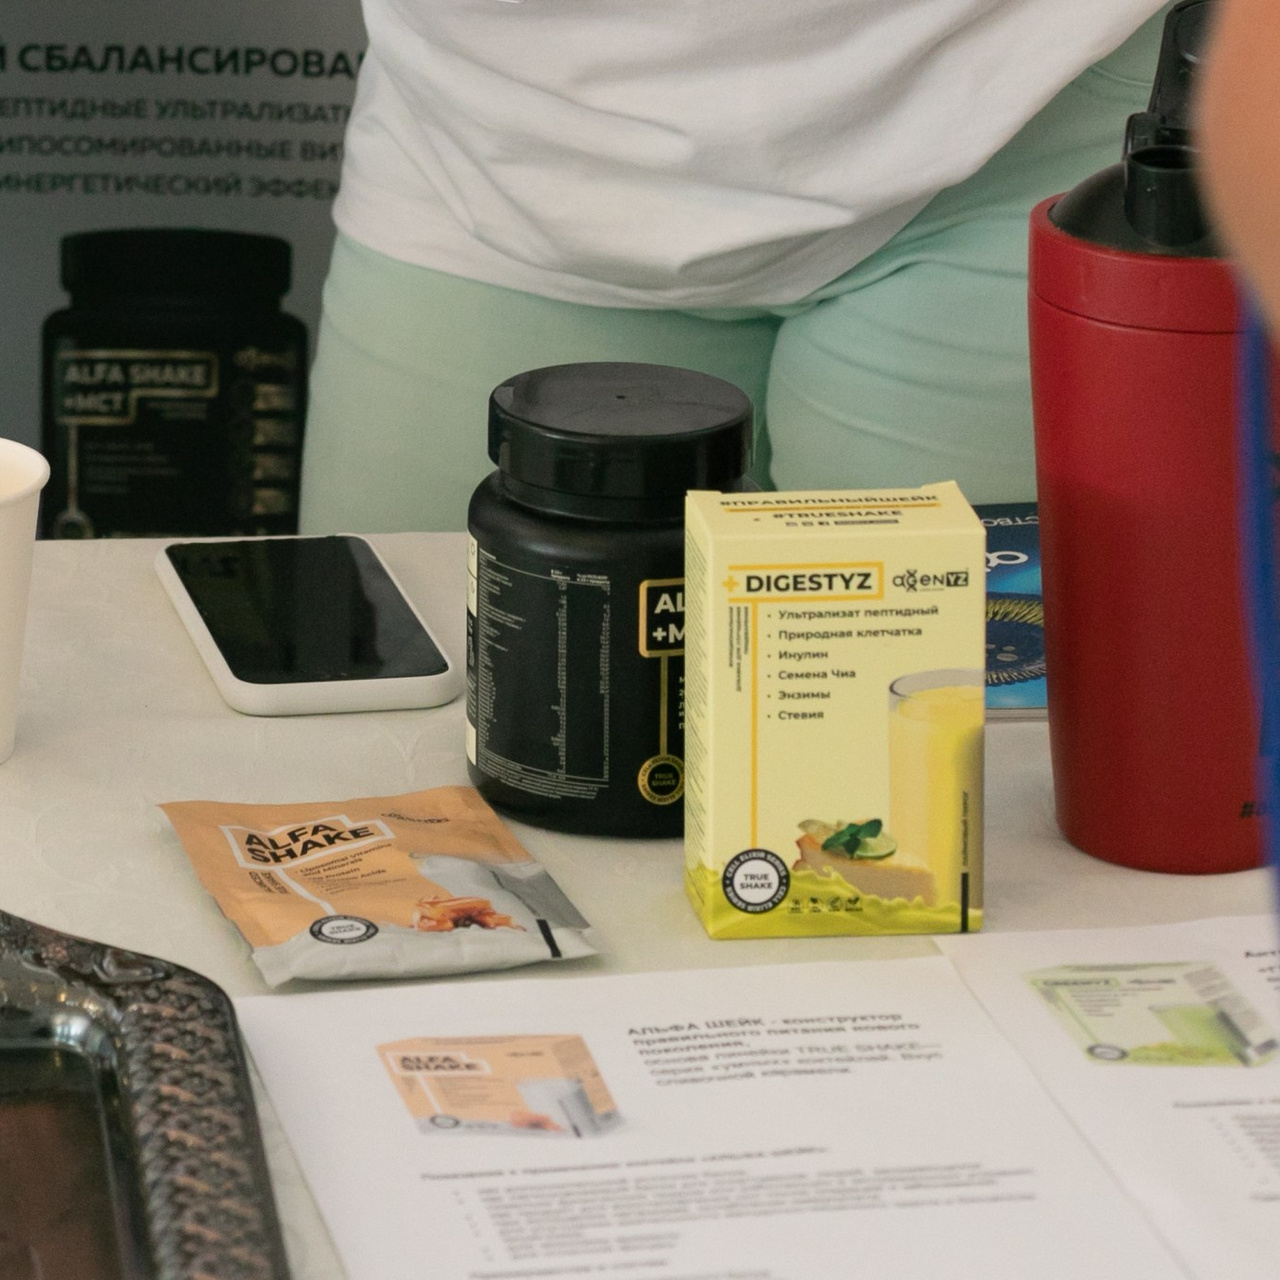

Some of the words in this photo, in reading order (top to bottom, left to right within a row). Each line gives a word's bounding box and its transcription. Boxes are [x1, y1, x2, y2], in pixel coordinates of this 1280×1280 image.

[746, 572, 873, 592] DIGESTYZ
[778, 608, 860, 620] Ультрализат
[864, 605, 940, 618] пептидный
[778, 629, 853, 641] Природная
[857, 627, 923, 638] клетчатка
[778, 650, 829, 662] Инулин
[778, 670, 828, 680] Семена
[831, 669, 857, 679] Чиа
[778, 690, 831, 700] Энзимы
[778, 710, 825, 720] Стевия
[246, 824, 339, 850] ALFA
[247, 826, 375, 864] SHAKE
[743, 873, 770, 881] TRUE
[628, 1022, 699, 1036] АЛЬФА
[705, 1017, 763, 1029] ШЕЙК
